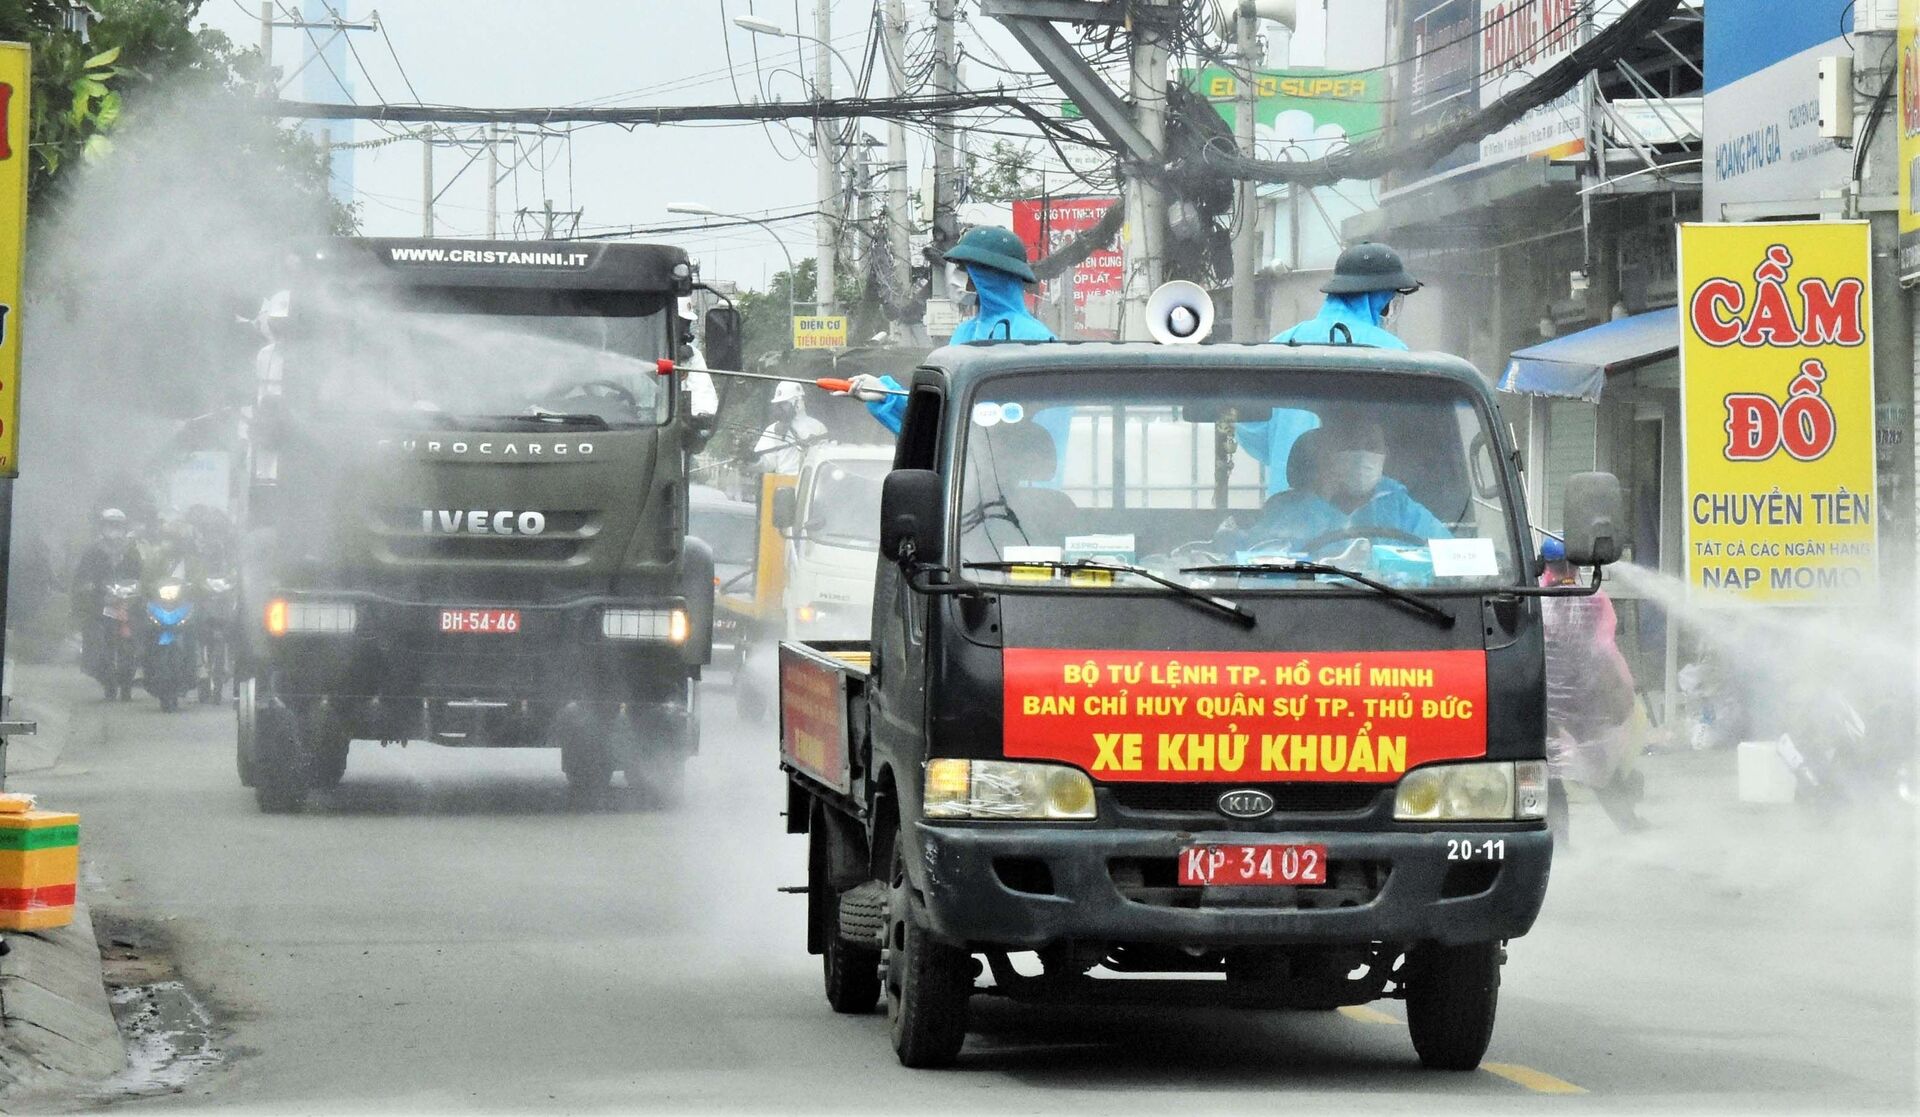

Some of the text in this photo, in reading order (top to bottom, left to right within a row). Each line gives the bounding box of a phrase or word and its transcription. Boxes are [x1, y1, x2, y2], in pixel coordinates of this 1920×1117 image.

[1280, 79, 1365, 97] SUPER
[1766, 123, 1781, 165] GIA
[391, 248, 588, 266] WWW.CRISTANINI.IT
[1099, 256, 1122, 268] CUNG
[1690, 244, 1865, 347] CẦM
[1723, 358, 1836, 462] ĐỒ
[1693, 486, 1869, 525] CHUYỂN TIỀN
[422, 510, 545, 535] IVECO
[1785, 539, 1825, 556] NGÂN
[1771, 567, 1861, 589] MOMO
[443, 612, 516, 630] BH-54-46
[1064, 658, 1434, 688] BỘ TƯ LỆNH TP. HỒ CHÍ MINH
[1023, 688, 1473, 721] BAN CHỈ HUY QUÂN SỰ TP. THỦ ĐỨC
[1091, 720, 1407, 773] XE KHỬ KHUẨN
[1228, 796, 1266, 812] KIA
[1448, 839, 1505, 860] 20-11
